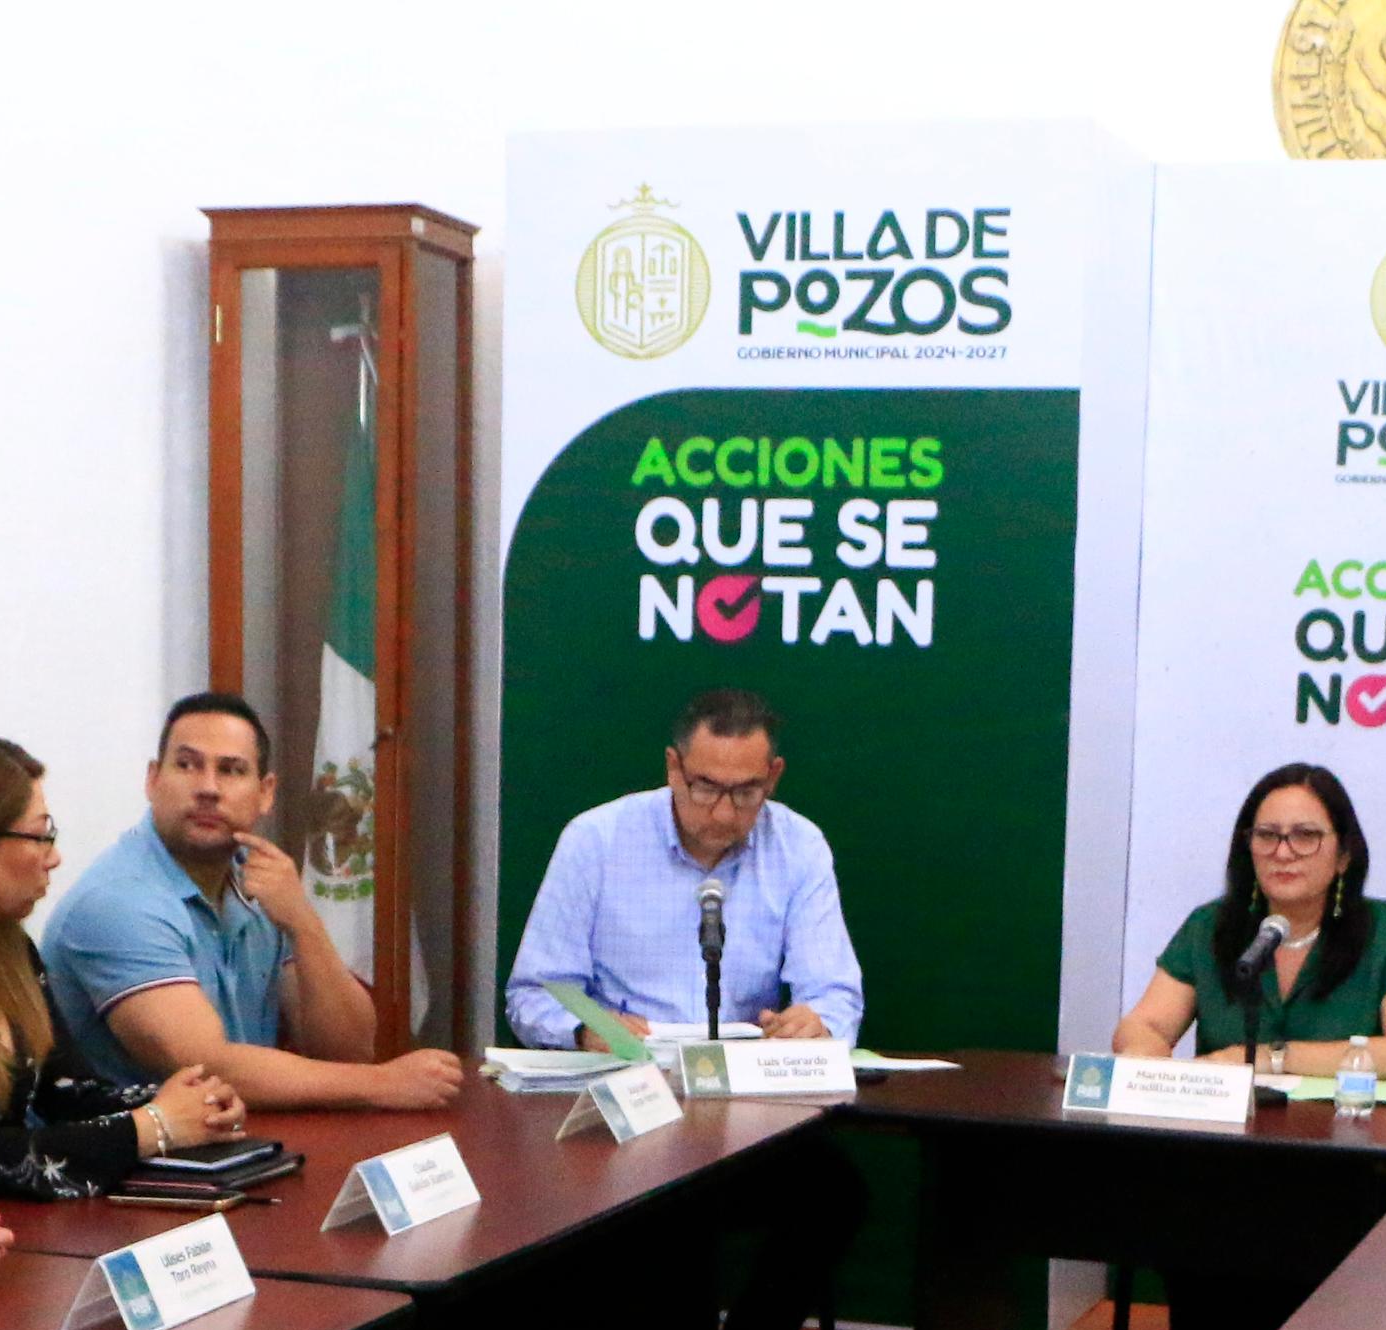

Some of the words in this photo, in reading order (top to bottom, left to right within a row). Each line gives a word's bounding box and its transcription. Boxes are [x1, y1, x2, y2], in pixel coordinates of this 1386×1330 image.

[736, 209, 913, 262] VILLA
[925, 207, 1011, 260] DE
[737, 268, 1012, 337] POZOS
[736, 346, 821, 360] GOBIERNO
[824, 346, 909, 360] MUNICIPAL
[913, 346, 1008, 360] 2024-2027
[631, 436, 945, 489] ACCIONES
[635, 496, 813, 568] QUE
[836, 499, 939, 569] SE
[638, 575, 934, 648] NOTAN
